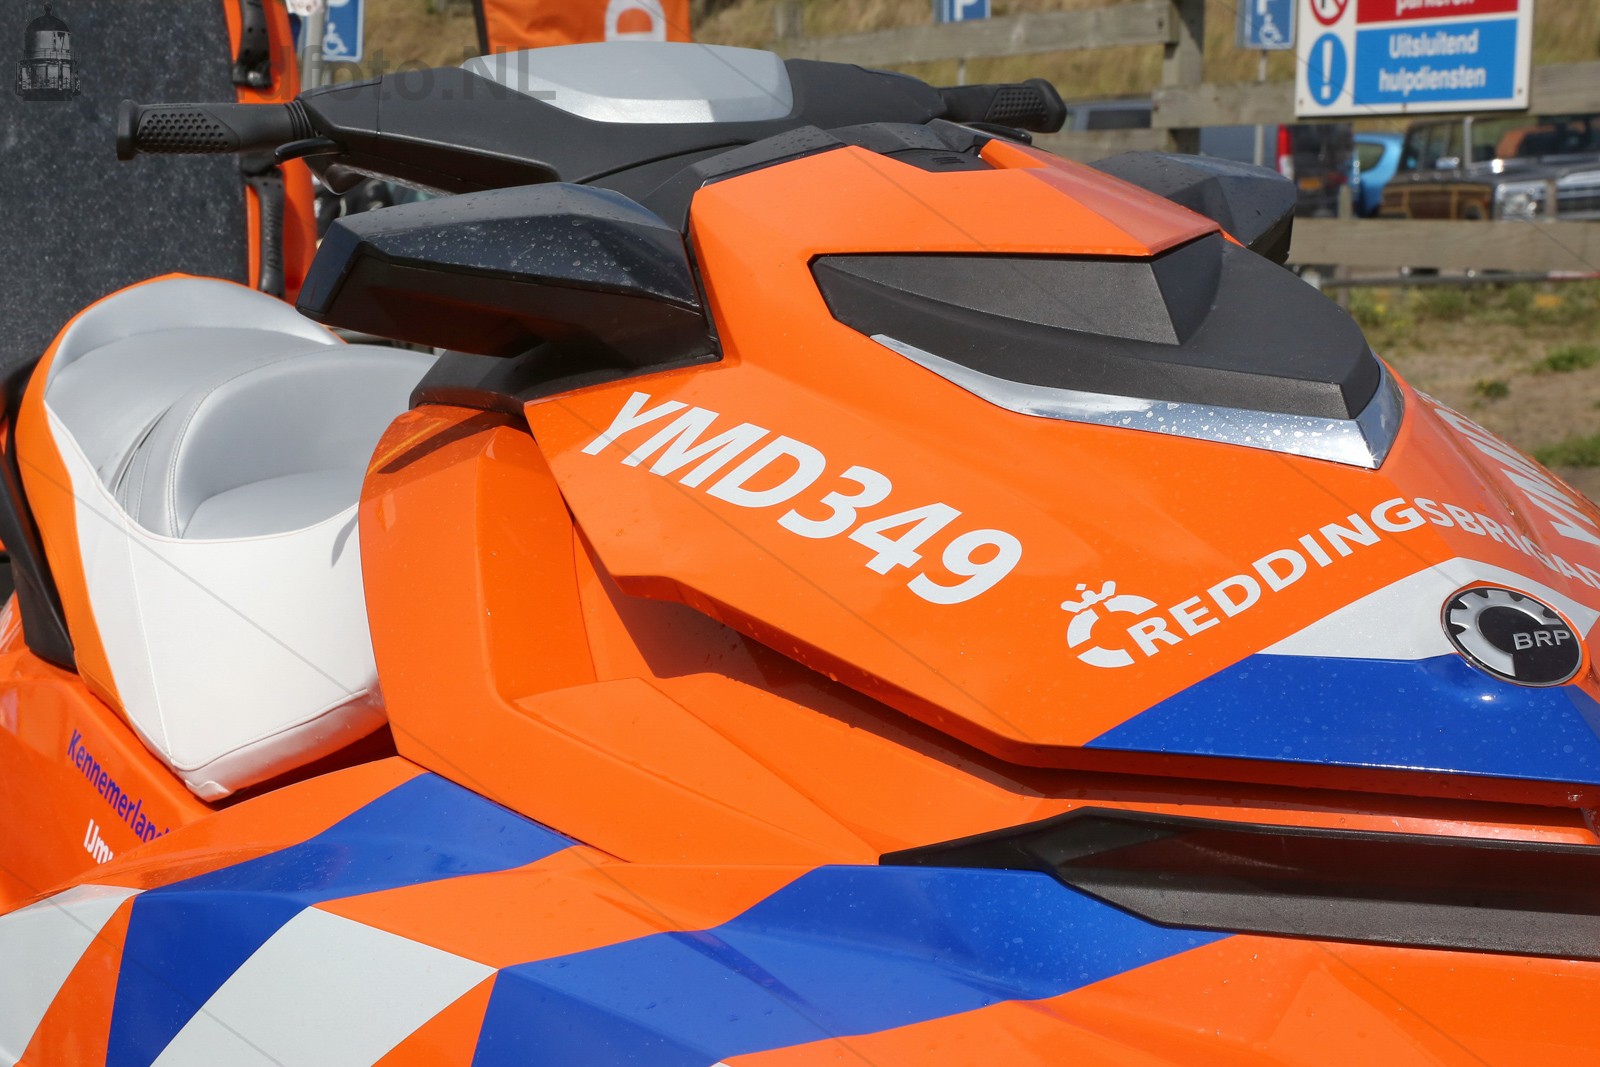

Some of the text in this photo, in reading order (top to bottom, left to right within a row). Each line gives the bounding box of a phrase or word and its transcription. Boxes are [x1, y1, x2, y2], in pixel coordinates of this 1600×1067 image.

[1389, 28, 1479, 59] Uitsluitend
[1379, 65, 1487, 97] hulpdiensten
[580, 391, 1023, 605] YMD349
[1512, 629, 1571, 651] BRP
[67, 728, 170, 843] Kennemerlan
